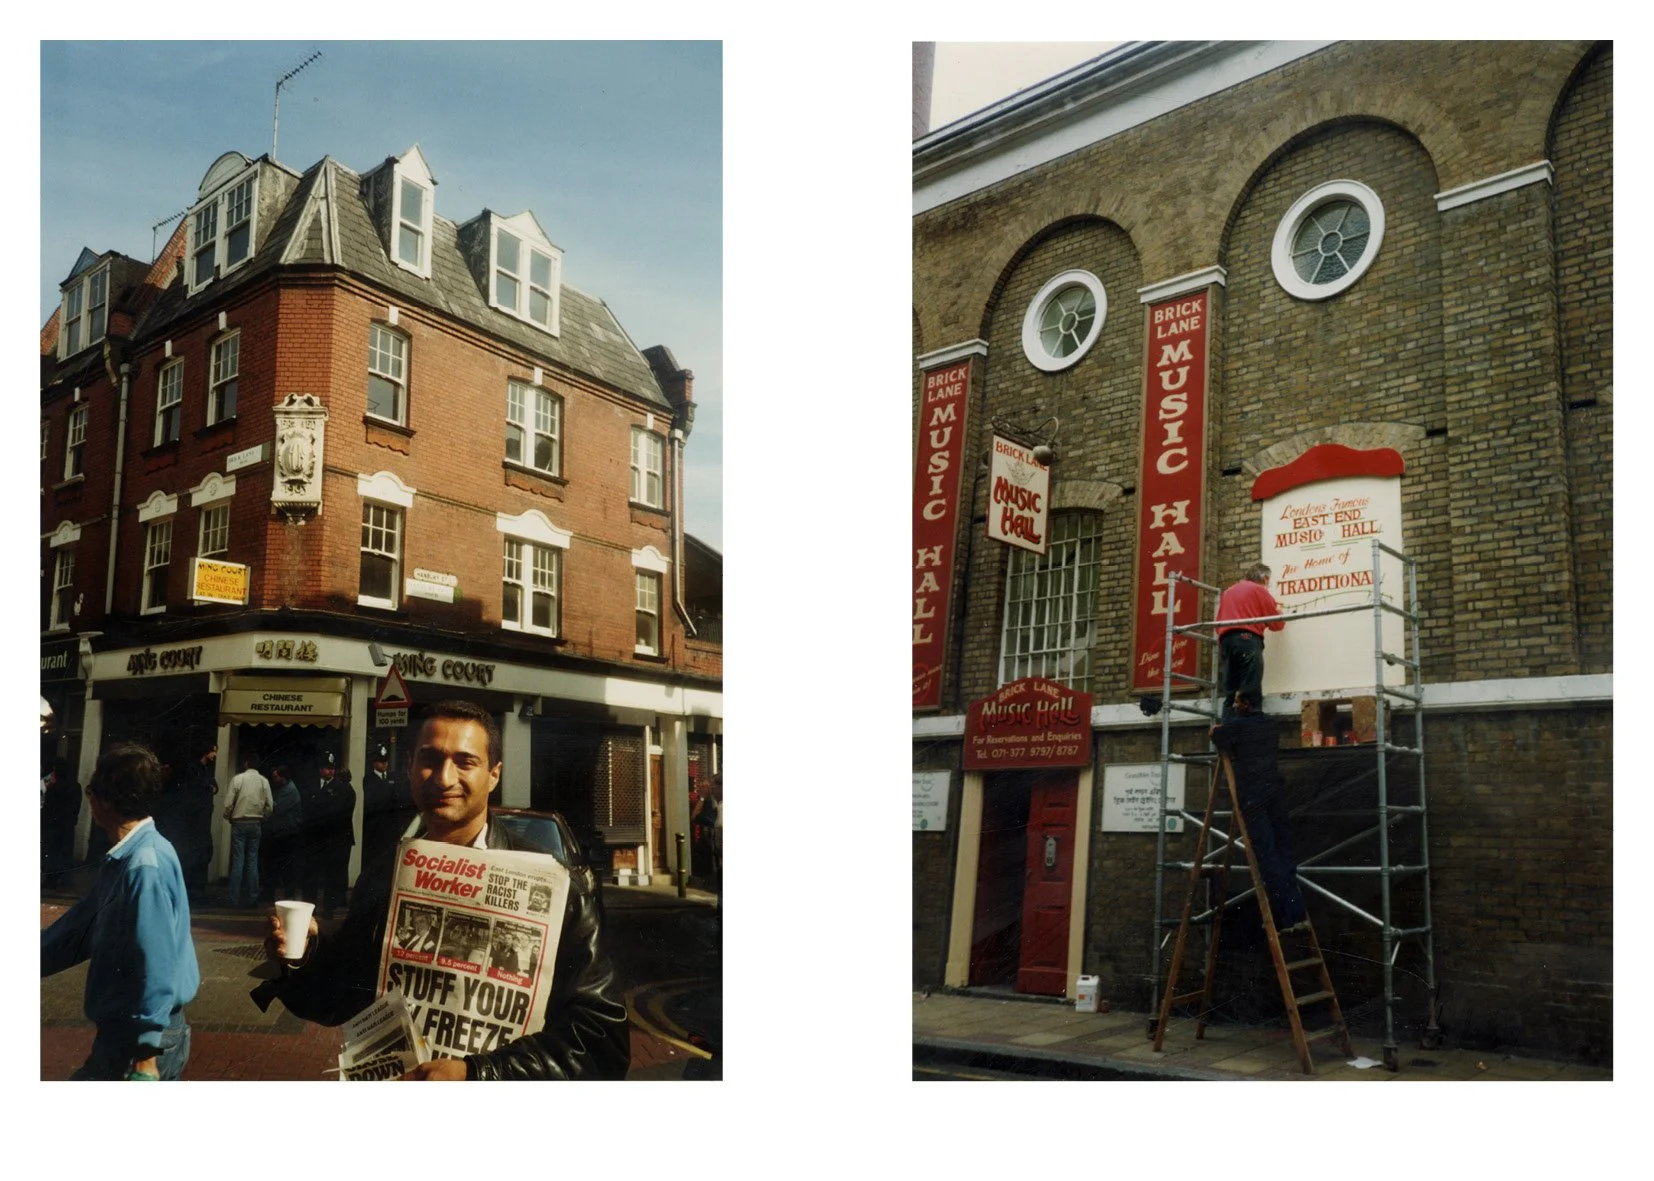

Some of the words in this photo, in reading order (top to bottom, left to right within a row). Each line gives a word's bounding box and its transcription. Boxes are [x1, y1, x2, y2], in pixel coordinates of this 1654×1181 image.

[1154, 299, 1202, 324] BRICK
[1157, 316, 1200, 339] LANE
[928, 366, 967, 389] BRICK
[928, 382, 962, 402] LANE
[1156, 339, 1194, 475] MUSIC
[922, 403, 957, 521] MUSIC
[996, 441, 1024, 462] BRICK
[1280, 503, 1327, 520] Londons
[1331, 497, 1370, 513] Famous
[1293, 513, 1329, 529] EAST
[1334, 509, 1361, 524] END
[1275, 529, 1324, 549] MUSIC
[1341, 520, 1378, 538] HALL
[1149, 499, 1191, 615] HALL
[1282, 564, 1298, 579] The
[1304, 555, 1333, 570] Home
[1338, 549, 1352, 565] of
[204, 573, 240, 586] CHINESE
[1277, 570, 1375, 596] TRADITIONA
[912, 545, 944, 645] HALL
[160, 645, 203, 671] COURT
[441, 658, 496, 687] COURT
[262, 693, 303, 702] CHINESE
[998, 682, 1026, 704] BRICK
[1033, 681, 1060, 699] LANE
[250, 703, 314, 712] RESTAURANT
[973, 735, 984, 745] For
[986, 734, 1028, 744] Reservations
[1031, 732, 1045, 742] and
[1047, 731, 1082, 743] Enquiries
[402, 848, 487, 880] Socialist
[490, 865, 504, 873] East
[505, 868, 527, 878] London
[414, 870, 483, 899] Worker
[486, 883, 518, 900] RACIST
[488, 873, 510, 887] STOP
[512, 878, 528, 891] THE
[484, 894, 520, 912] KILLERS
[405, 951, 429, 962] percent
[452, 960, 478, 972] percent
[496, 970, 524, 985] Nothing
[387, 962, 457, 1005] STUFF
[462, 976, 530, 1025] YOUR
[422, 1007, 514, 1055] FREEZE
